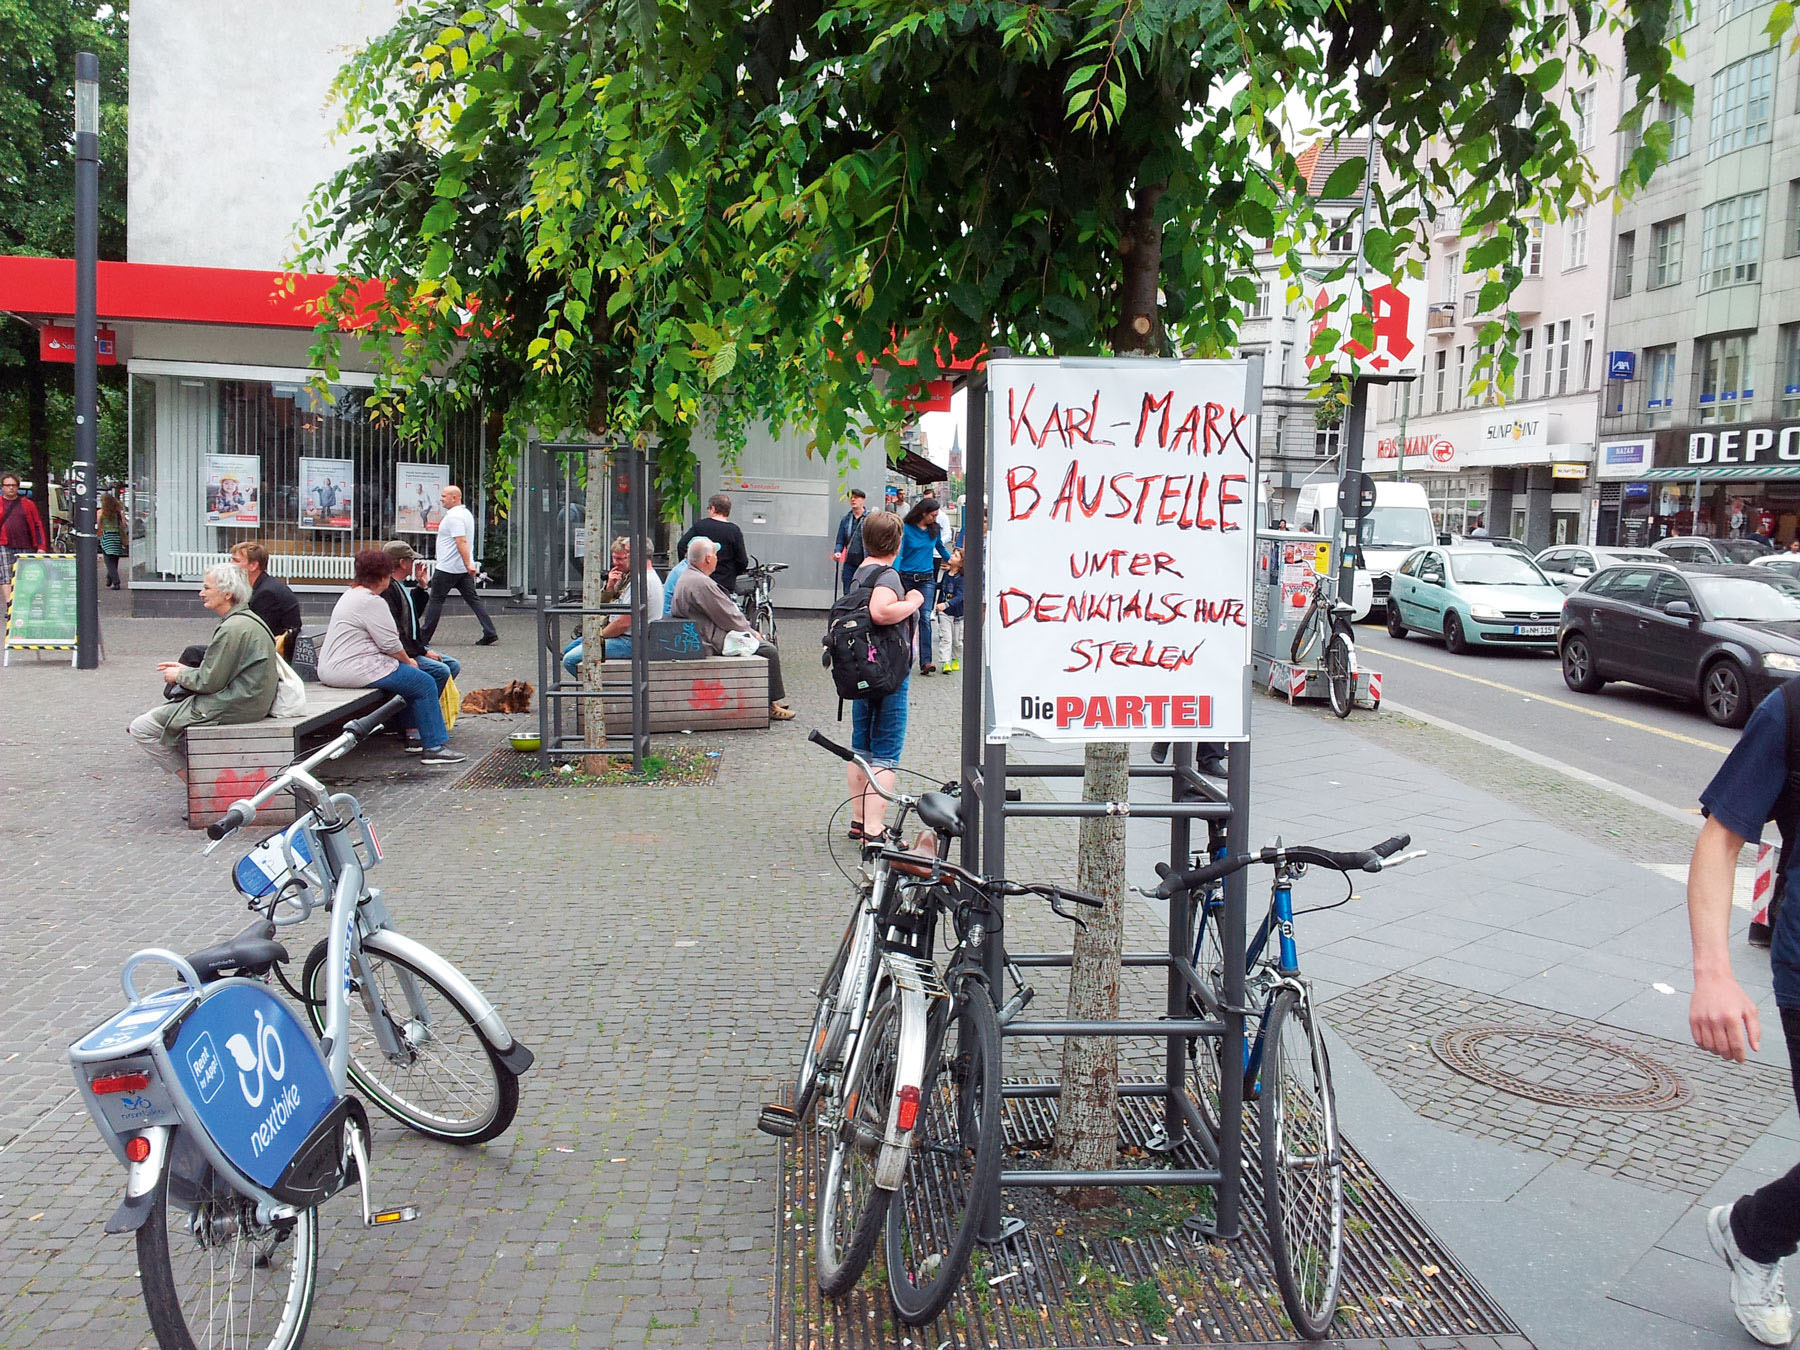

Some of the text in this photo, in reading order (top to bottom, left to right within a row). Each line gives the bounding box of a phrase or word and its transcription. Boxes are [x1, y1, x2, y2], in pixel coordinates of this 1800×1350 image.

[1063, 638, 1206, 673] STELLEN
[1020, 695, 1214, 729] Die PARTEI
[193, 1046, 210, 1078] Rent
[251, 1084, 300, 1158] nextbike
